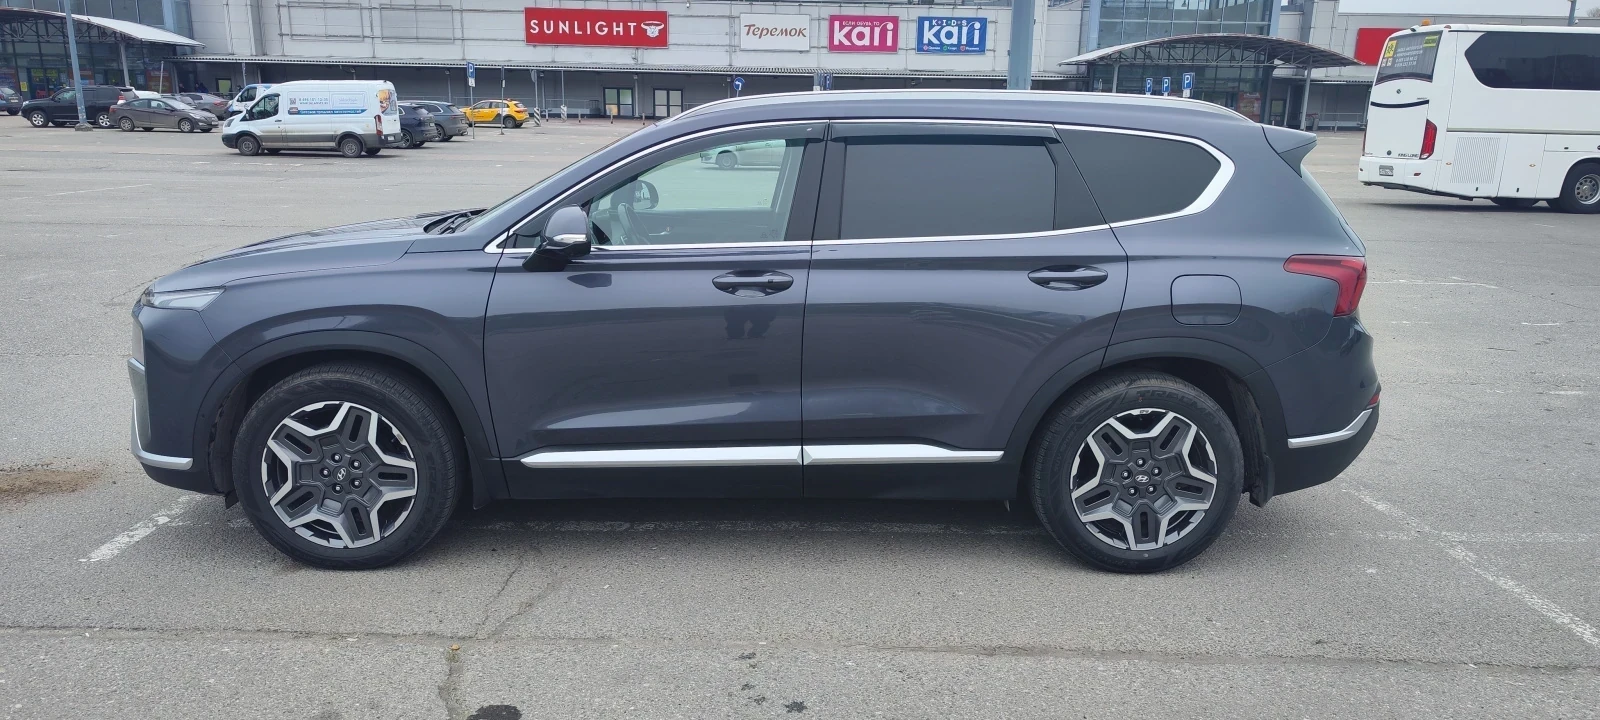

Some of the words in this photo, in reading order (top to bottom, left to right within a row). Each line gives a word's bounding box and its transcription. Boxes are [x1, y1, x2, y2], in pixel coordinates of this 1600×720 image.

[529, 19, 638, 36] SUNLIGHT
[743, 24, 807, 39] Теремок
[833, 20, 894, 46] kari
[923, 20, 981, 45] kari
[1163, 79, 1169, 91] P
[1184, 75, 1191, 88] P
